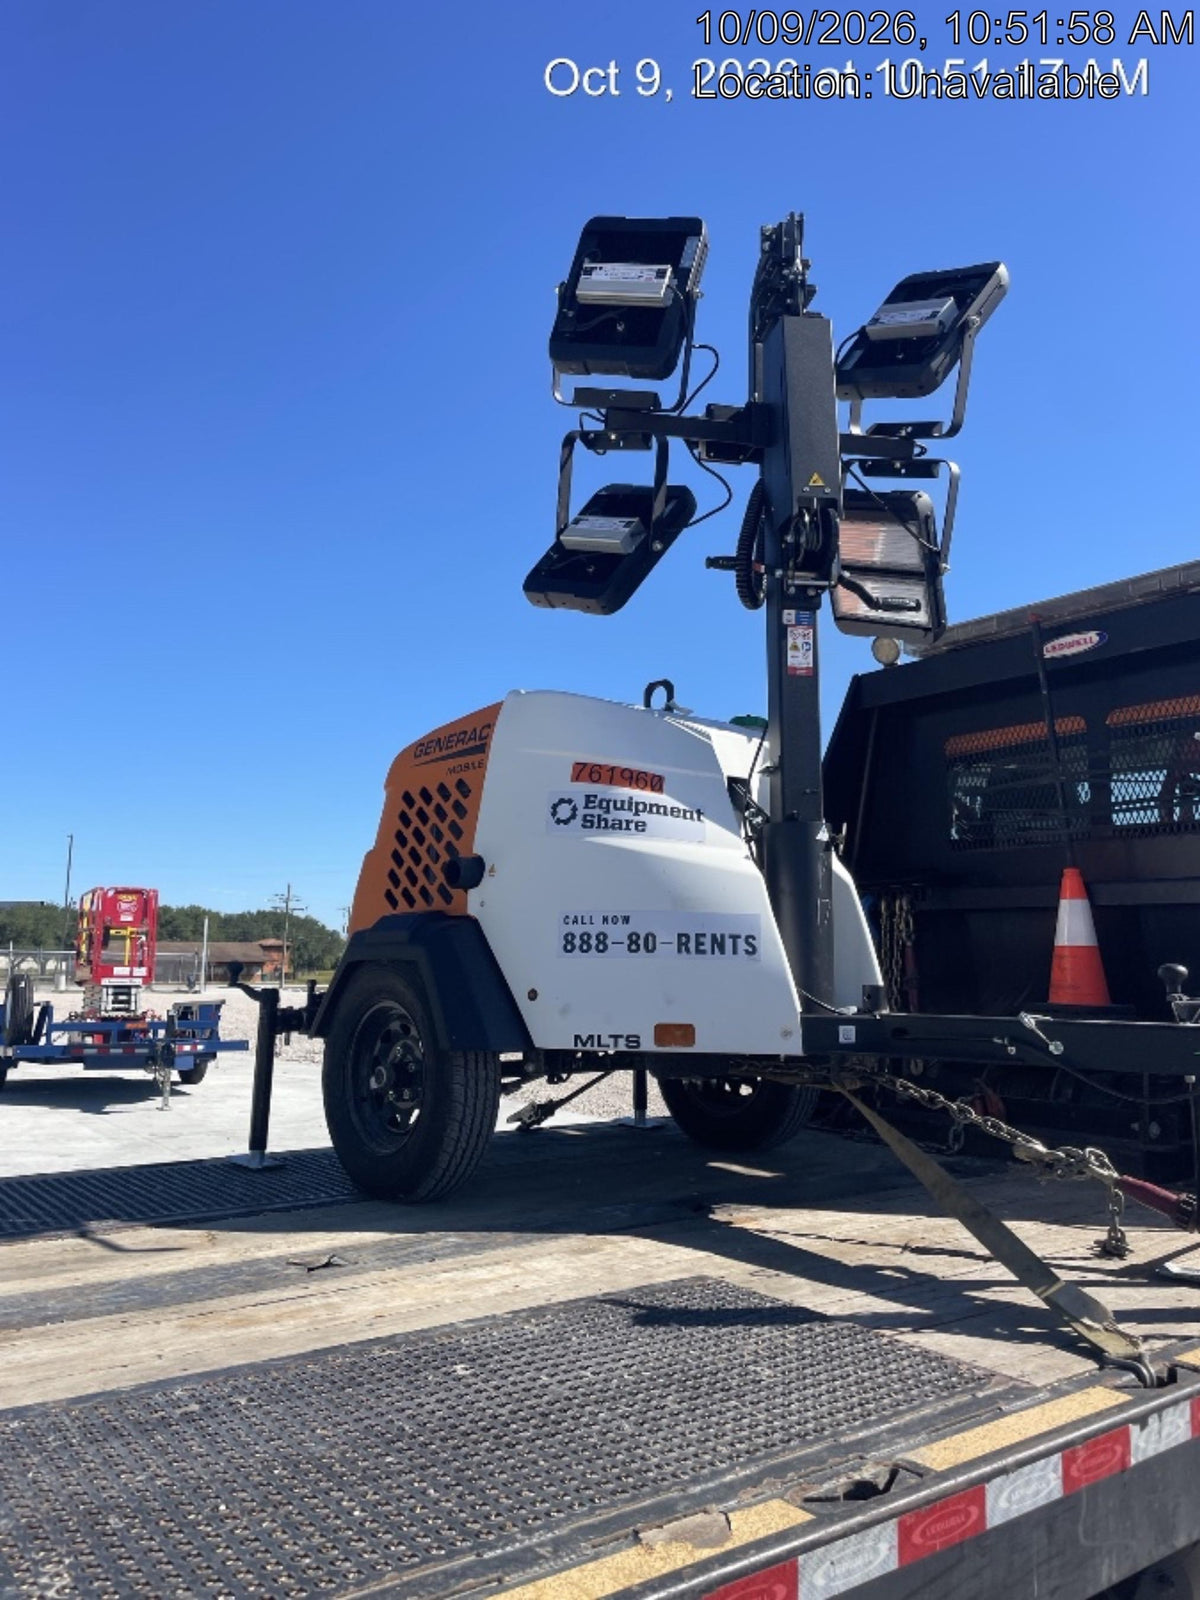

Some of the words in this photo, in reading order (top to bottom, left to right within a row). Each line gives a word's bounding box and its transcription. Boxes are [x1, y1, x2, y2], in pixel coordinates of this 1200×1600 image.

[413, 723, 492, 758] GENERAC
[575, 762, 664, 792] 761960
[583, 794, 705, 823] Equipment
[581, 814, 647, 833] Share
[563, 914, 595, 925] CALL
[602, 914, 631, 925] NOW
[563, 931, 758, 956] 888-80-RENTS
[573, 1034, 641, 1049] MLTS
